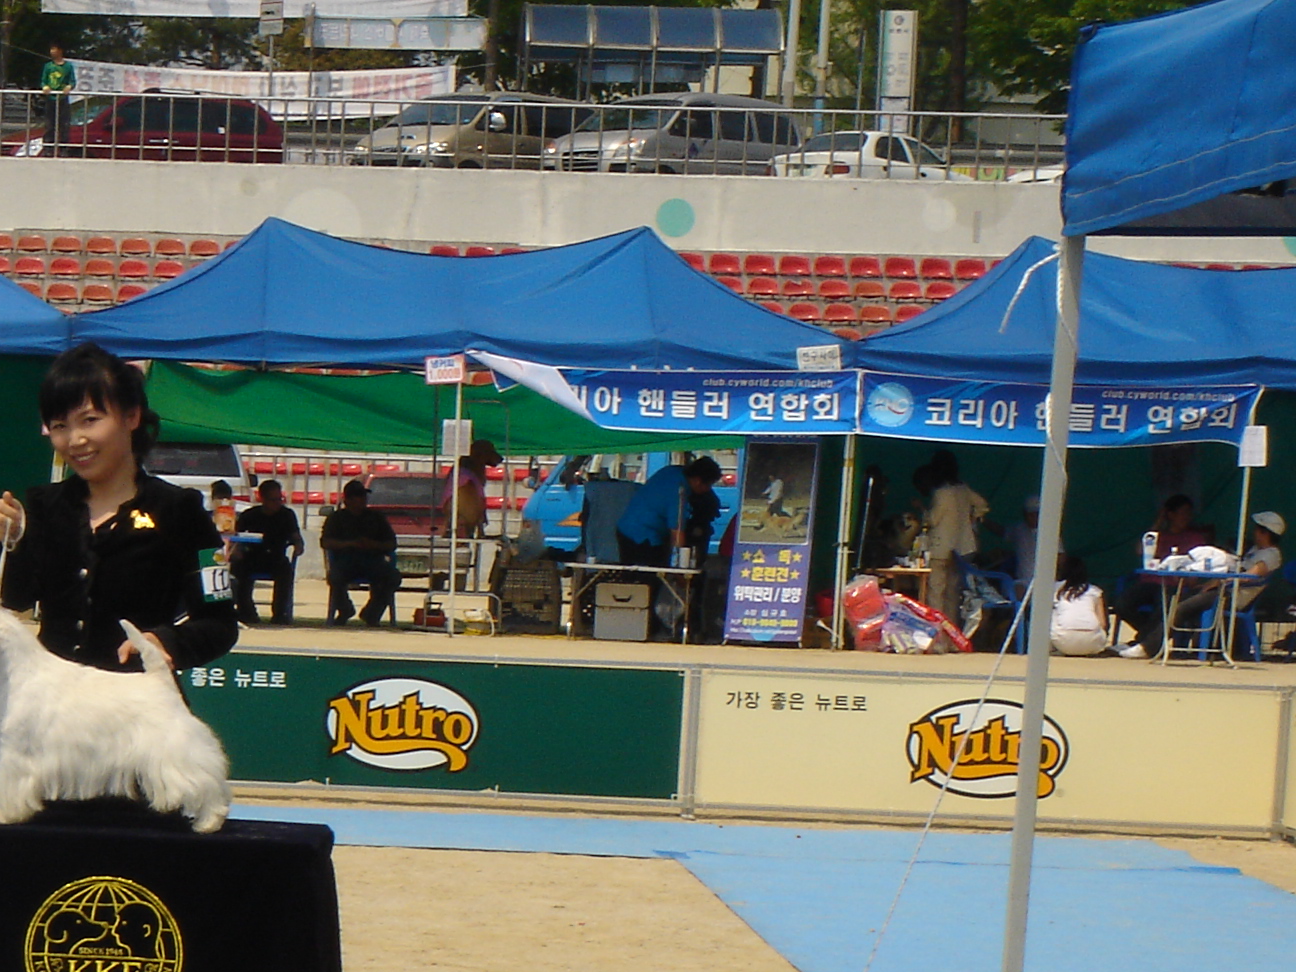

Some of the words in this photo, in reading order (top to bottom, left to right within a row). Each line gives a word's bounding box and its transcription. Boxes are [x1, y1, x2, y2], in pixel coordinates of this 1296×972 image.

[639, 389, 729, 420] 핸들러
[748, 392, 840, 422] 연합회
[924, 398, 1017, 431] 코리아
[1147, 404, 1237, 434] 연합회
[190, 667, 225, 687] 좋은
[234, 669, 287, 689] 뉴트로
[726, 691, 760, 709] 가장
[770, 692, 805, 711] 좋은
[815, 694, 868, 712] 뉴트로
[329, 688, 473, 763] Nutro
